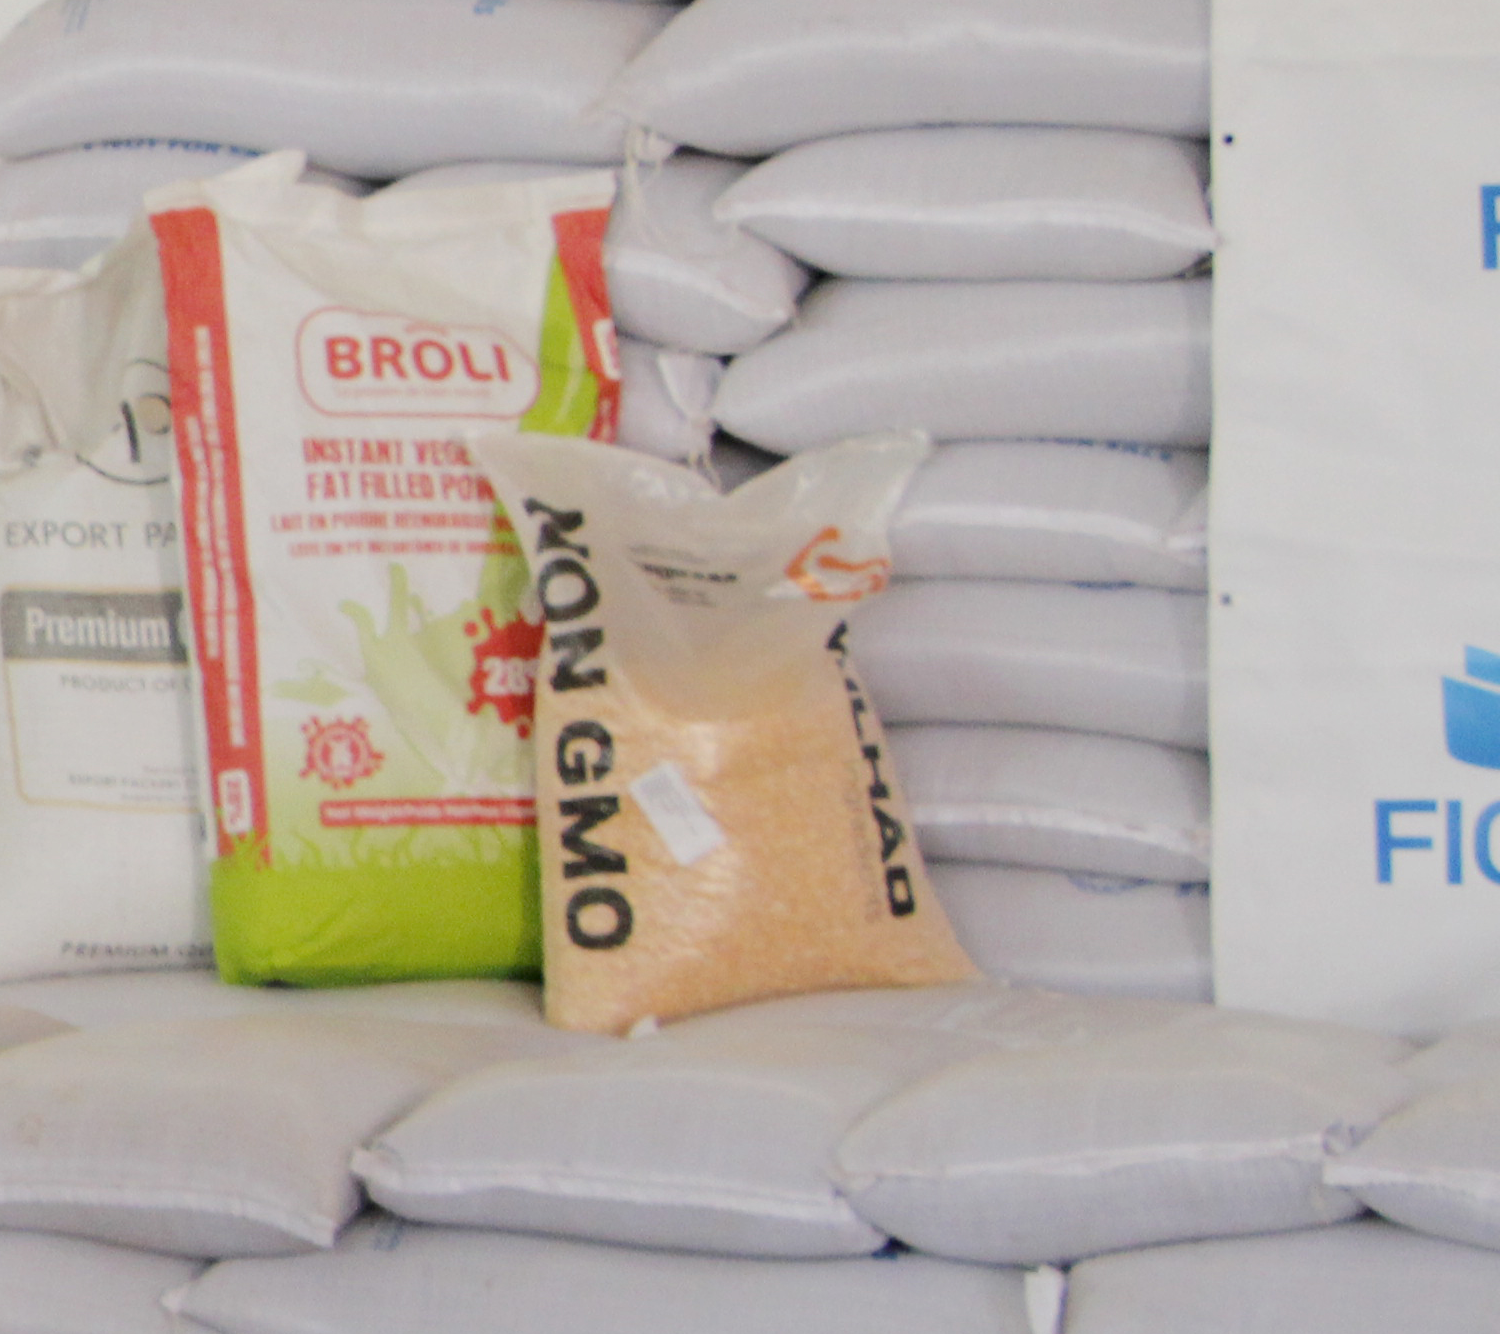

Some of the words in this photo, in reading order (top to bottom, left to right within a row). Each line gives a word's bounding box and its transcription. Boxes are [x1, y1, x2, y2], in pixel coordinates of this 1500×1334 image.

[325, 334, 511, 383] BROLI
[303, 437, 402, 465] INSTANT
[307, 470, 350, 501] FAT
[360, 471, 435, 500] FILLED
[4, 521, 128, 549] EXPORT
[522, 497, 608, 693] NON
[25, 605, 171, 648] Premium
[555, 718, 635, 952] GMO
